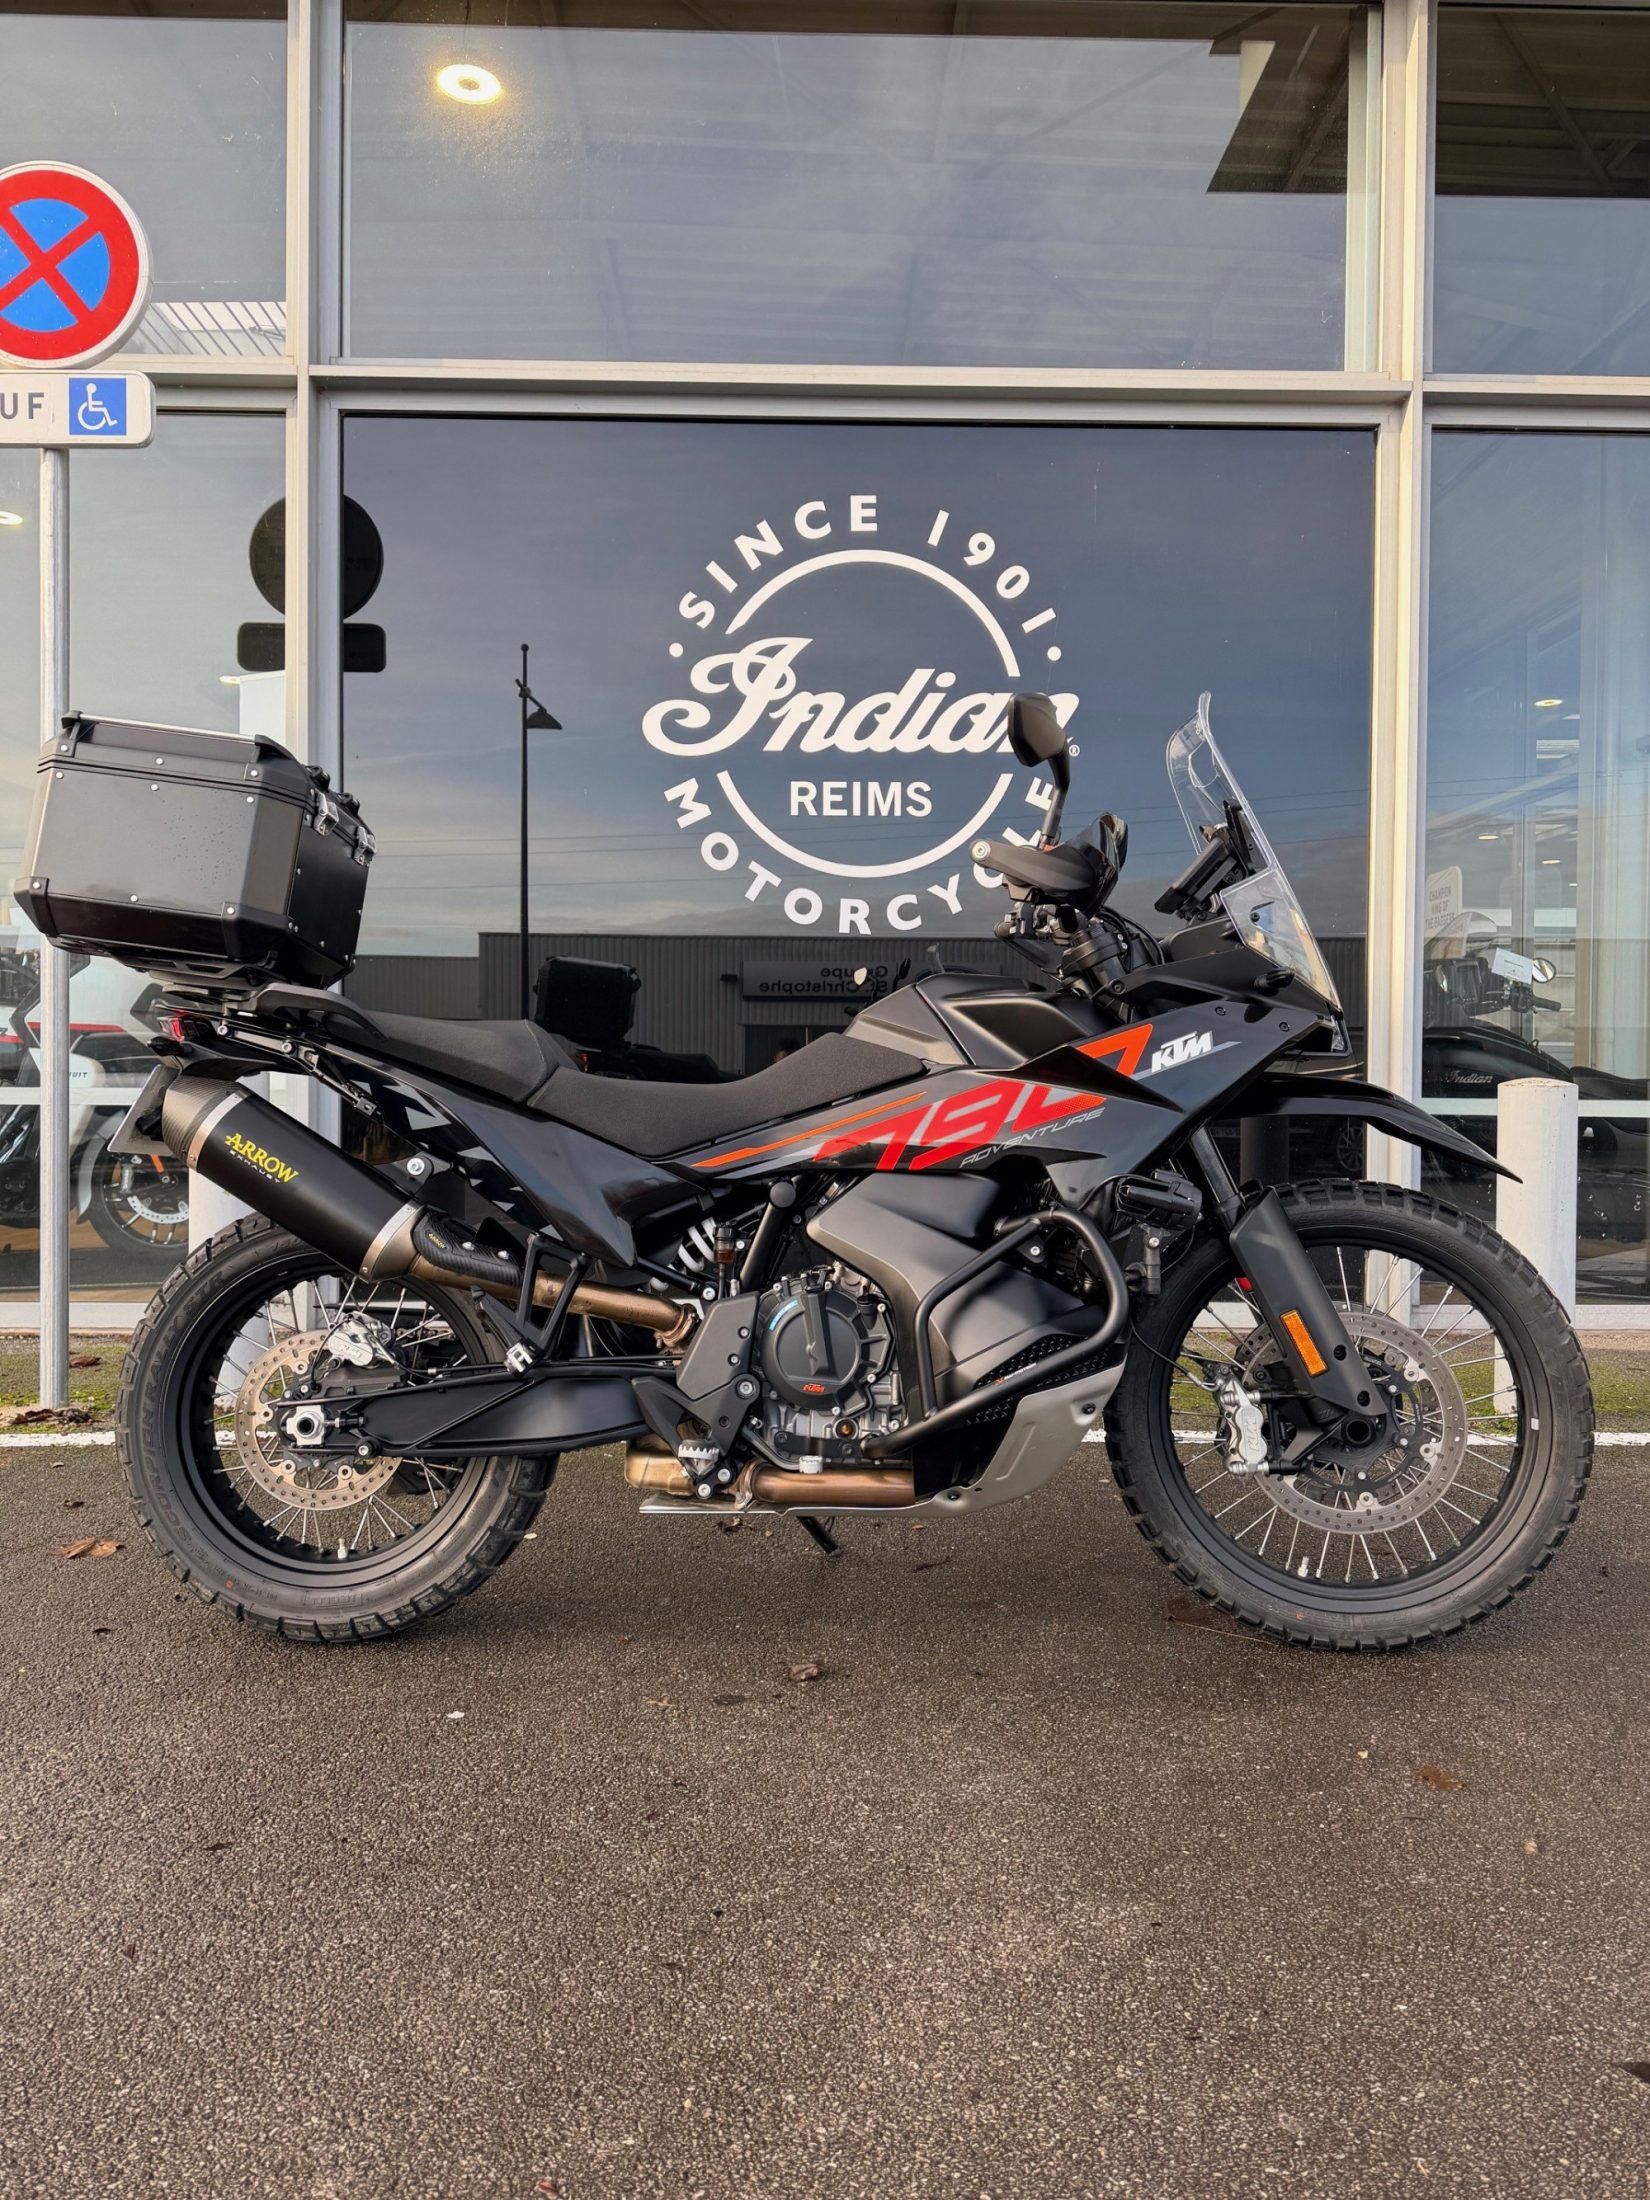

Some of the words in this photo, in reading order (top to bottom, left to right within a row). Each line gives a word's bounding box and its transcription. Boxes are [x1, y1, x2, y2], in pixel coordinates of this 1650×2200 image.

[679, 495, 878, 629] SINCE
[928, 509, 1057, 634] 1901
[790, 782, 933, 817] REIMS
[1151, 1030, 1213, 1073] KTM
[1441, 1070, 1493, 1084] Indian
[224, 1132, 299, 1183] ARROW
[960, 1107, 1106, 1169] ADVENTURE
[801, 1383, 825, 1393] KTM
